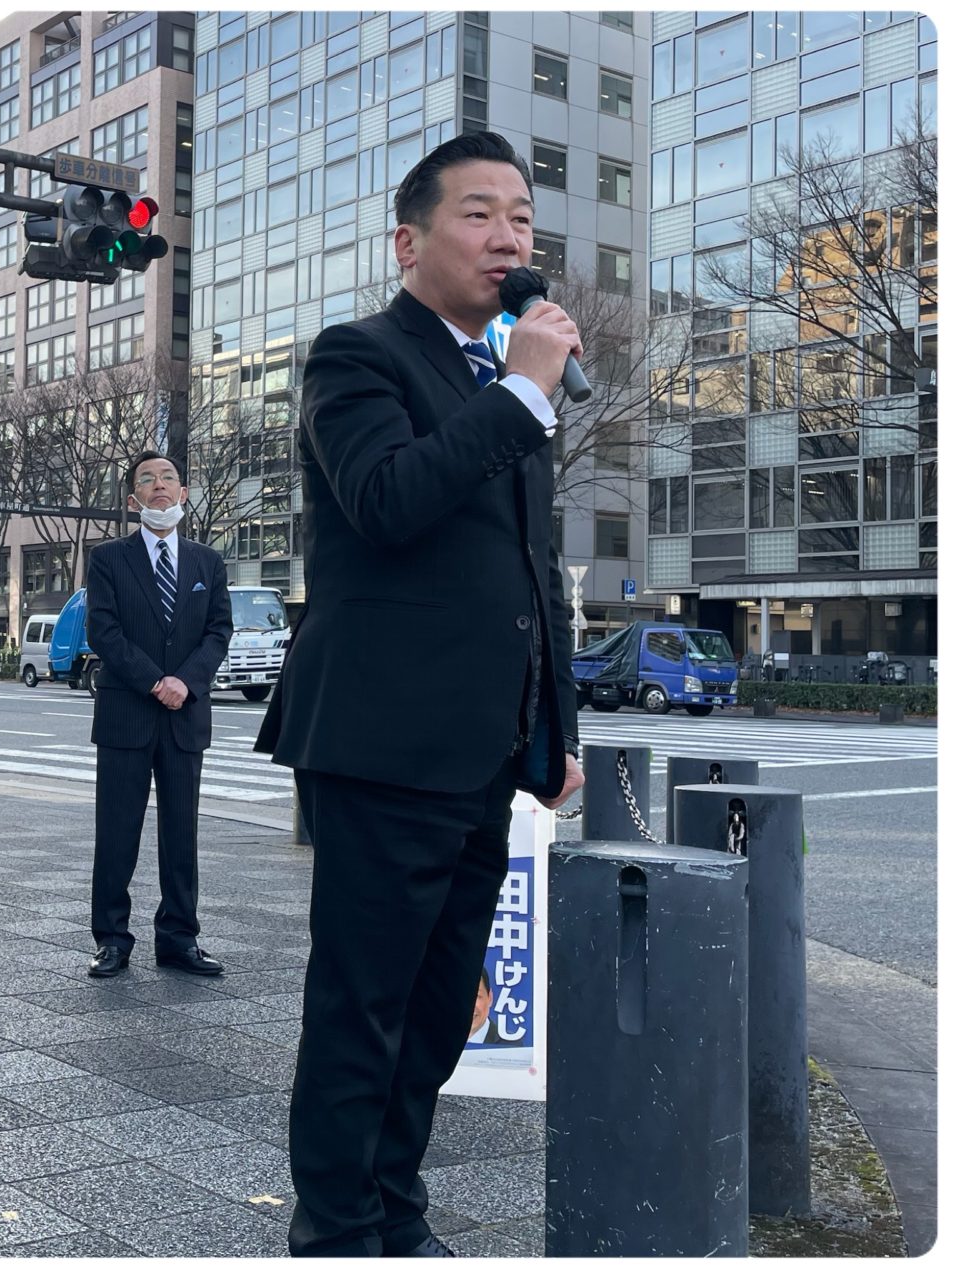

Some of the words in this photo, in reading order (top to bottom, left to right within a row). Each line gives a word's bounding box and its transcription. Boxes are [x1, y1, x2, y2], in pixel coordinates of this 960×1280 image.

[59, 157, 136, 187] 歩車分離信号
[627, 581, 635, 593] P
[487, 871, 529, 1042] 田中けんじ
